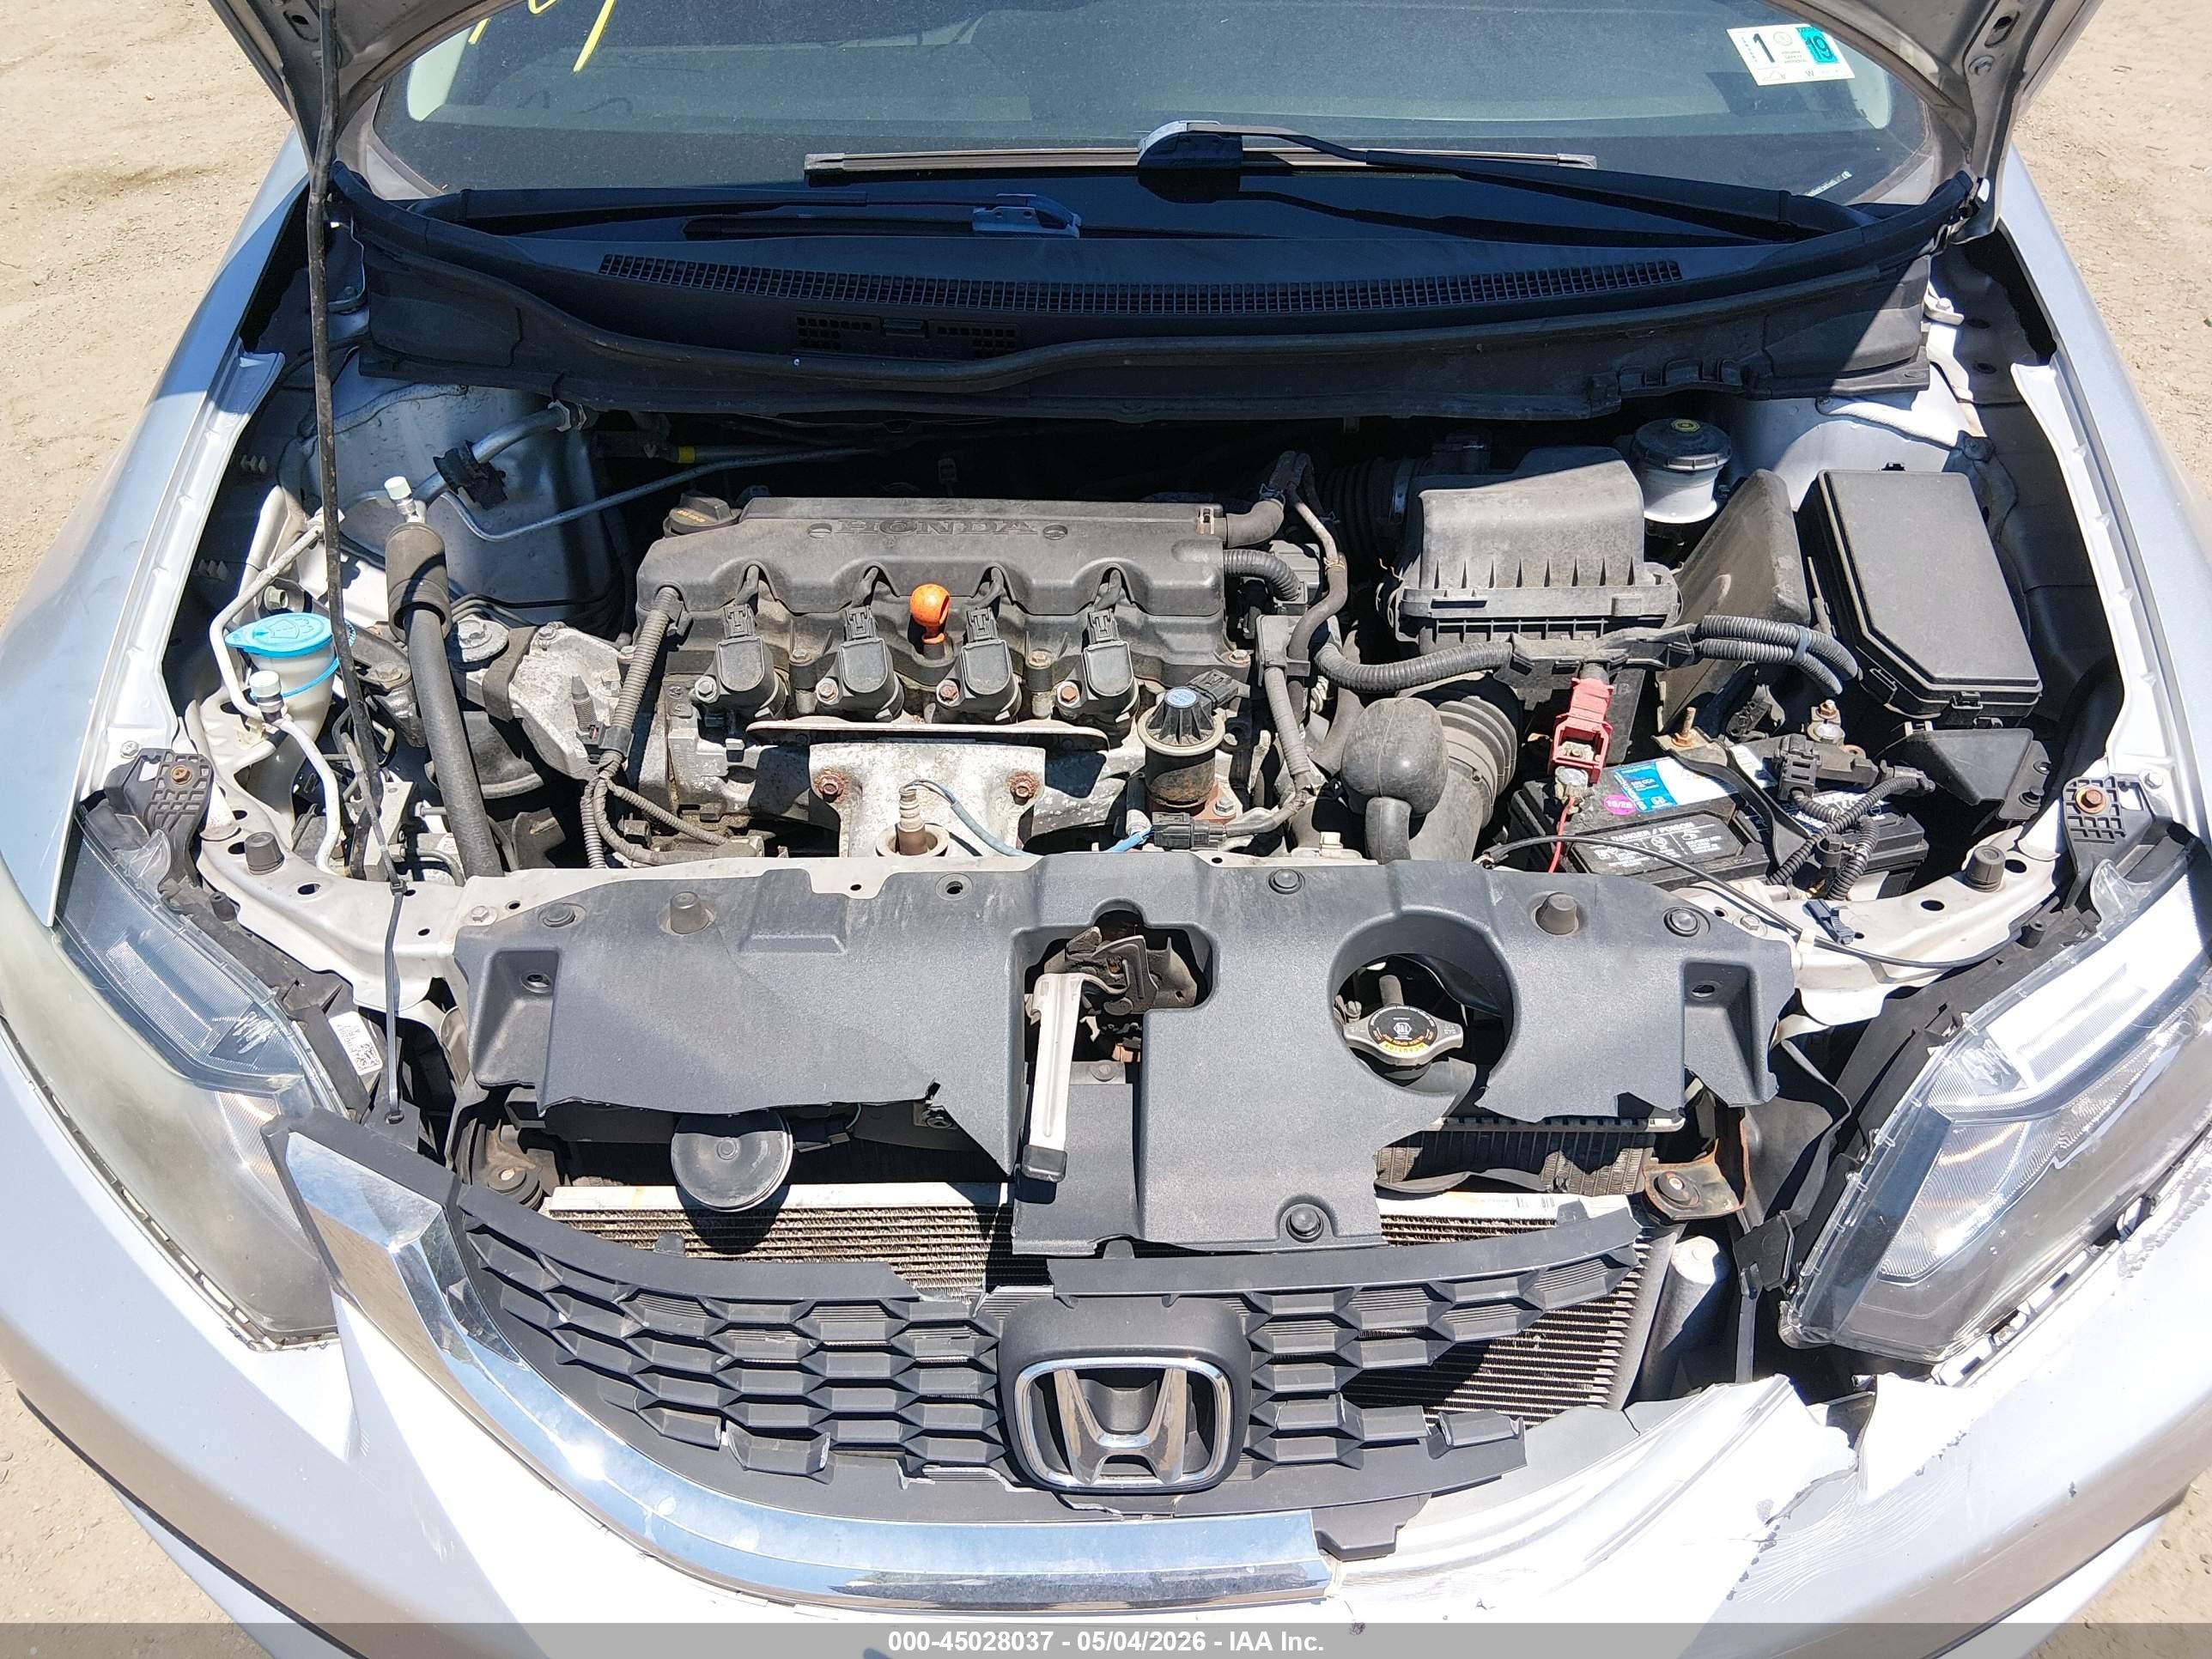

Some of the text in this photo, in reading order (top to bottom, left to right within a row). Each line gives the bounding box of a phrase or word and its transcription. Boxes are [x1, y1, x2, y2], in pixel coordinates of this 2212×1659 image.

[1753, 33, 1776, 63] 1
[1805, 34, 1834, 60] 19
[834, 520, 1038, 535] HONDA
